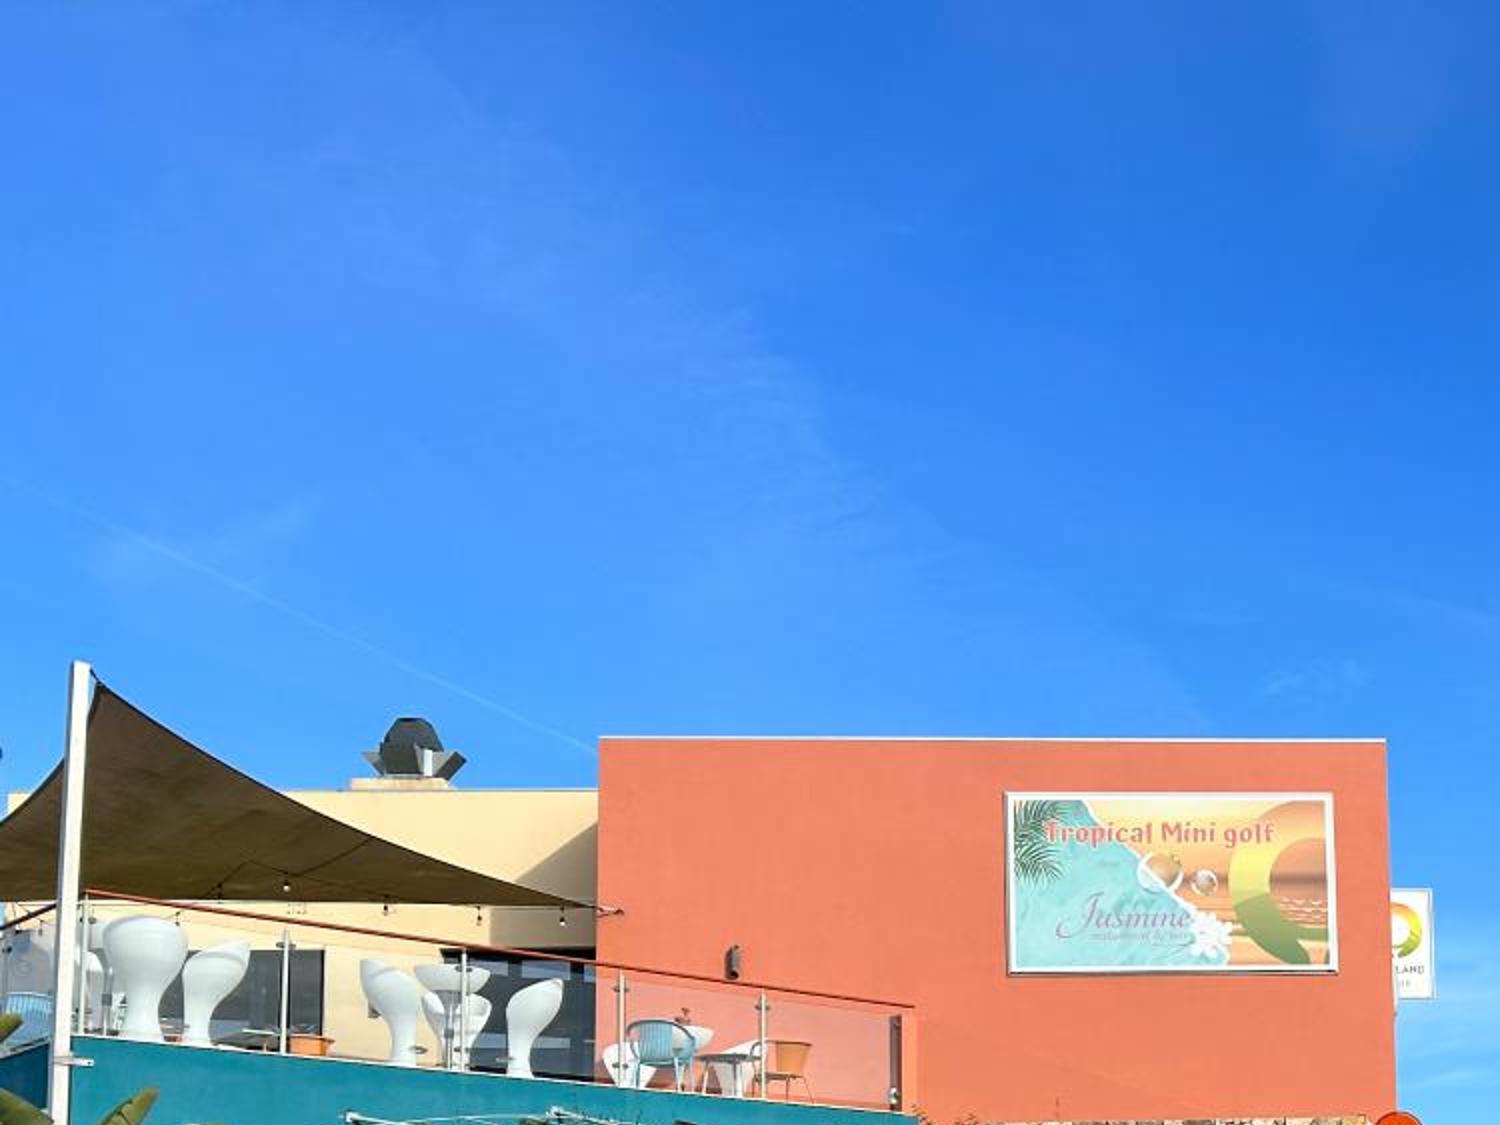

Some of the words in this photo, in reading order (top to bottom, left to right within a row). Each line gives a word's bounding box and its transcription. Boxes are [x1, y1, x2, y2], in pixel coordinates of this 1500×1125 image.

[1046, 821, 1153, 848] Tropical
[1161, 821, 1217, 844] Mini
[1223, 824, 1274, 848] golf
